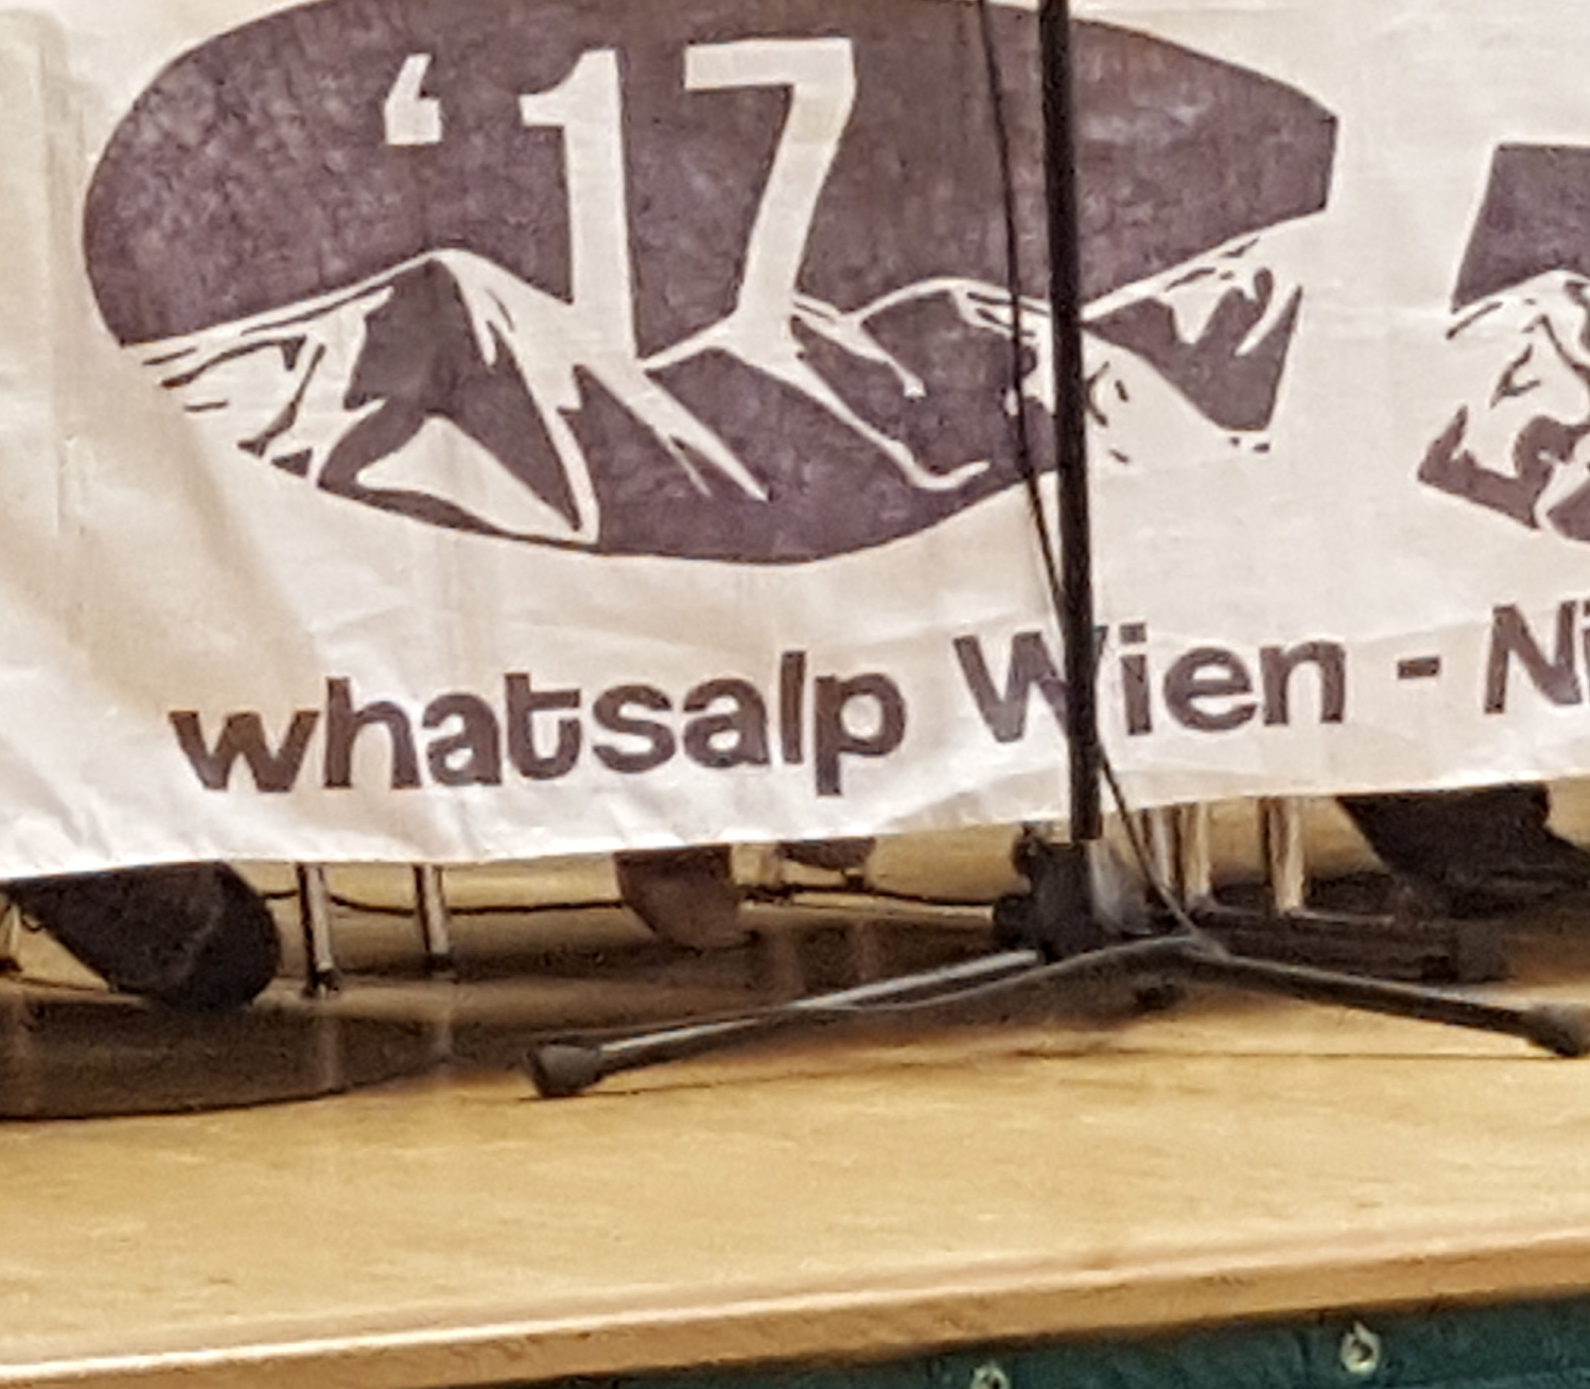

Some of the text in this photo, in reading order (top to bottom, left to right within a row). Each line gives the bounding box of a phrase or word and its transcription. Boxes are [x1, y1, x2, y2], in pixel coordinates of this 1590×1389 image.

[168, 649, 908, 797] whatsalp
[952, 621, 1347, 744] Wien
[1396, 654, 1443, 681] -
